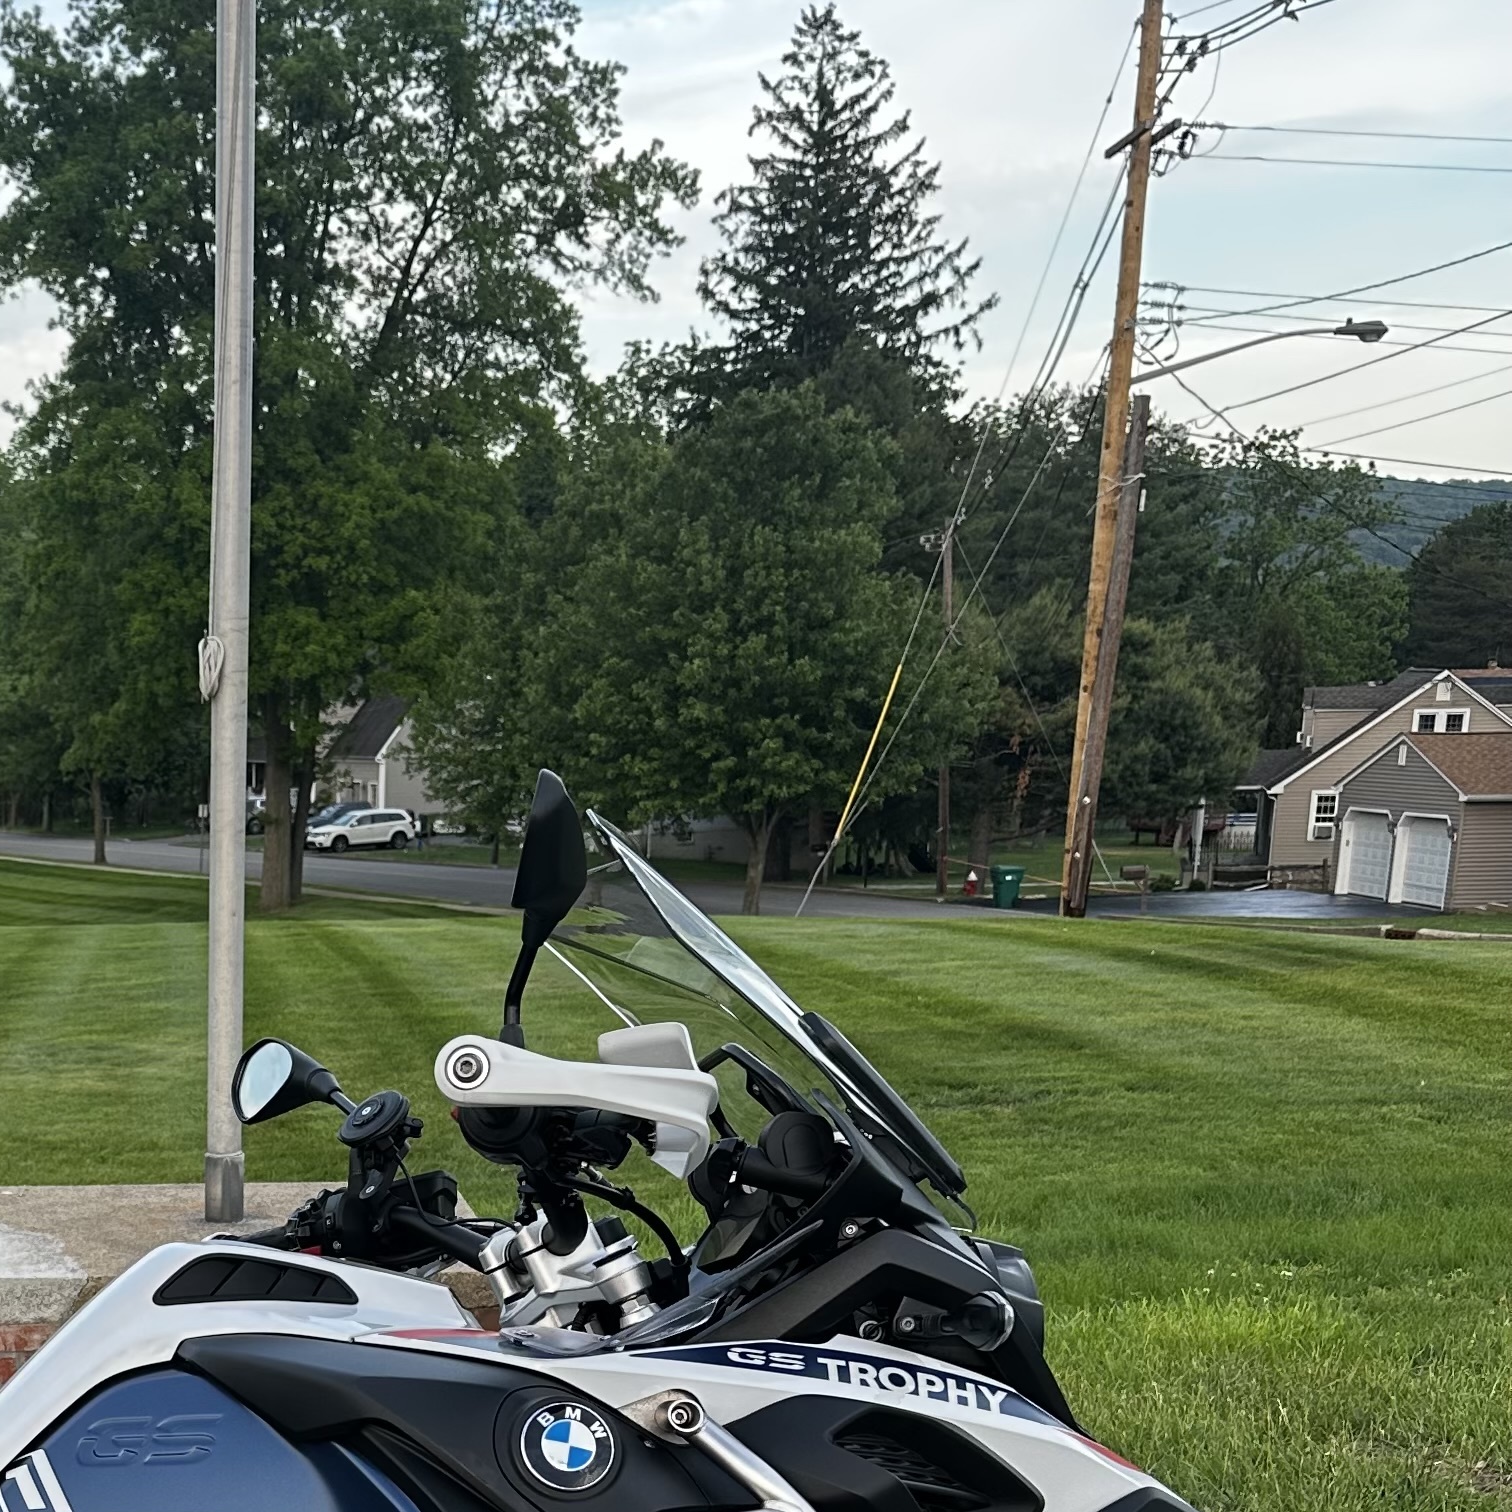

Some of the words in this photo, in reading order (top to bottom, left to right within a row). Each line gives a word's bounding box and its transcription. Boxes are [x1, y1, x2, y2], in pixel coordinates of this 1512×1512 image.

[727, 1347, 806, 1371] GS
[817, 1356, 1009, 1413] TROPHY
[76, 1413, 224, 1466] GS
[535, 1405, 608, 1439] BMW
